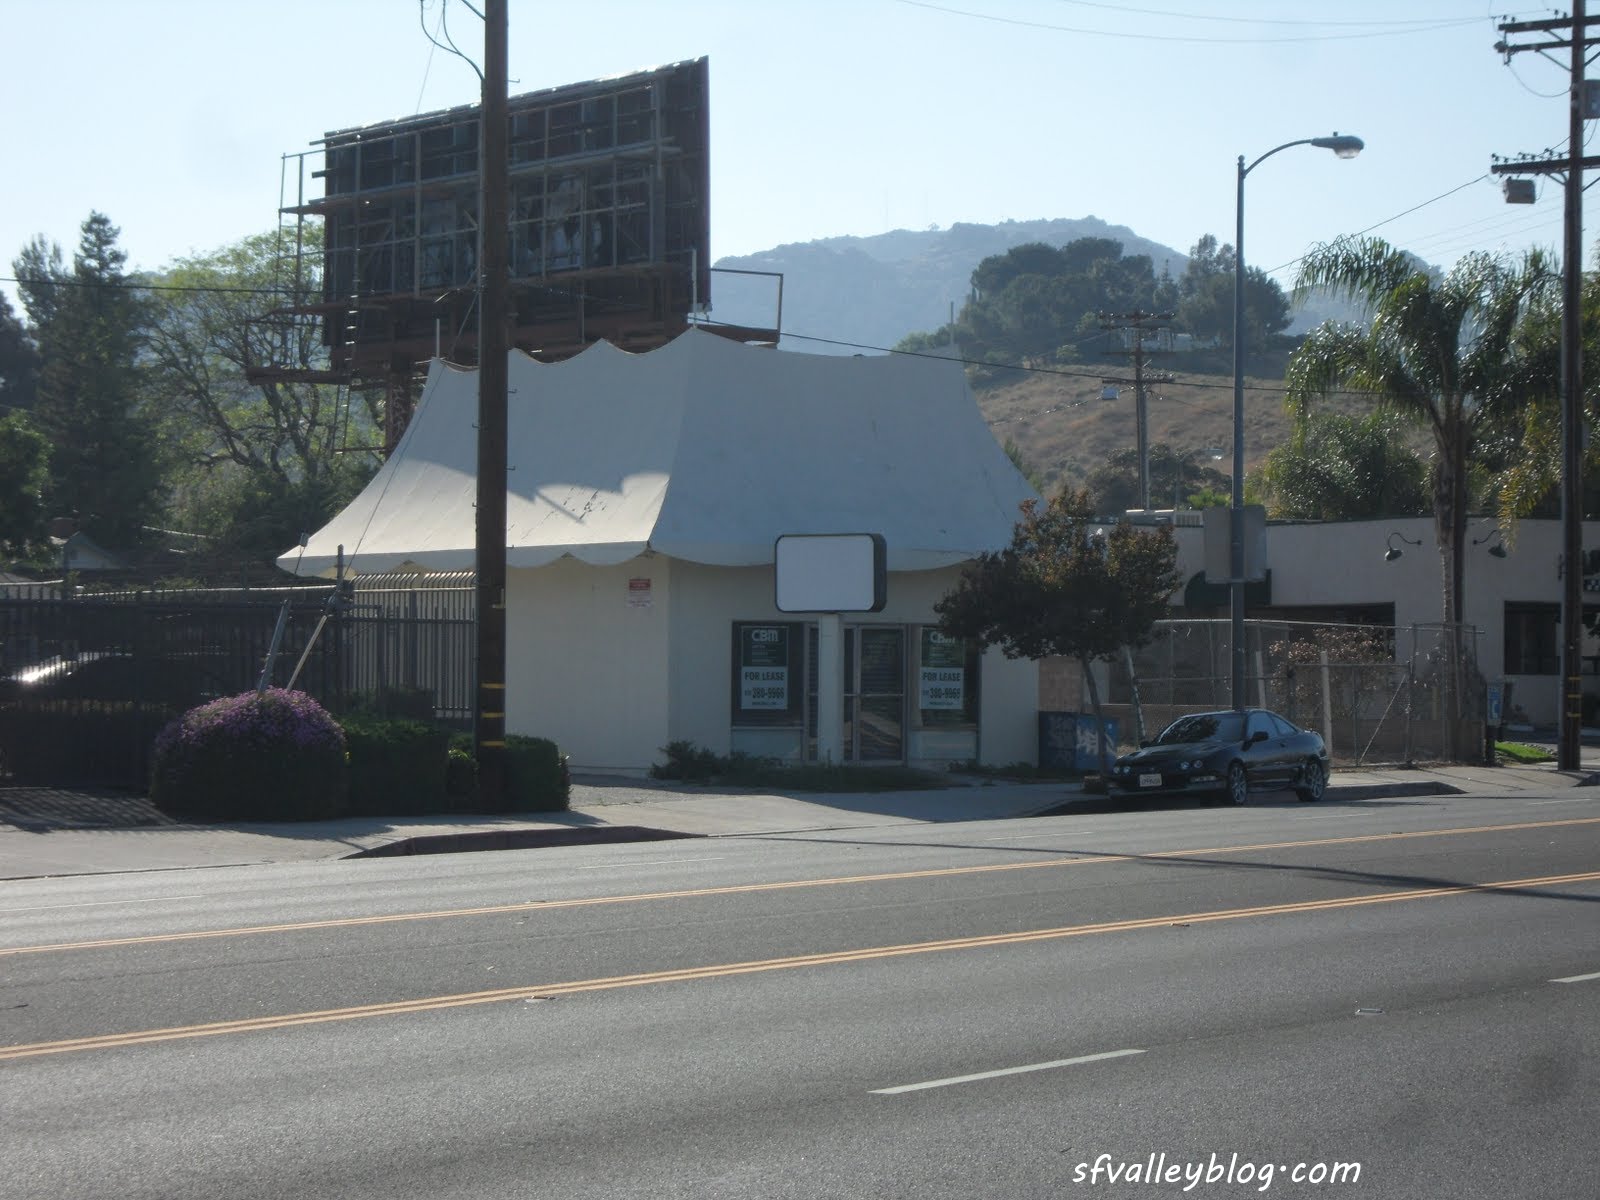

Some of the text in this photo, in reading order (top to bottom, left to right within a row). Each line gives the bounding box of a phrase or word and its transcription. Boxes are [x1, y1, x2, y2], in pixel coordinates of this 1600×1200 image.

[744, 672, 784, 680] FOR LEASE
[923, 672, 960, 681] FOR LEASE
